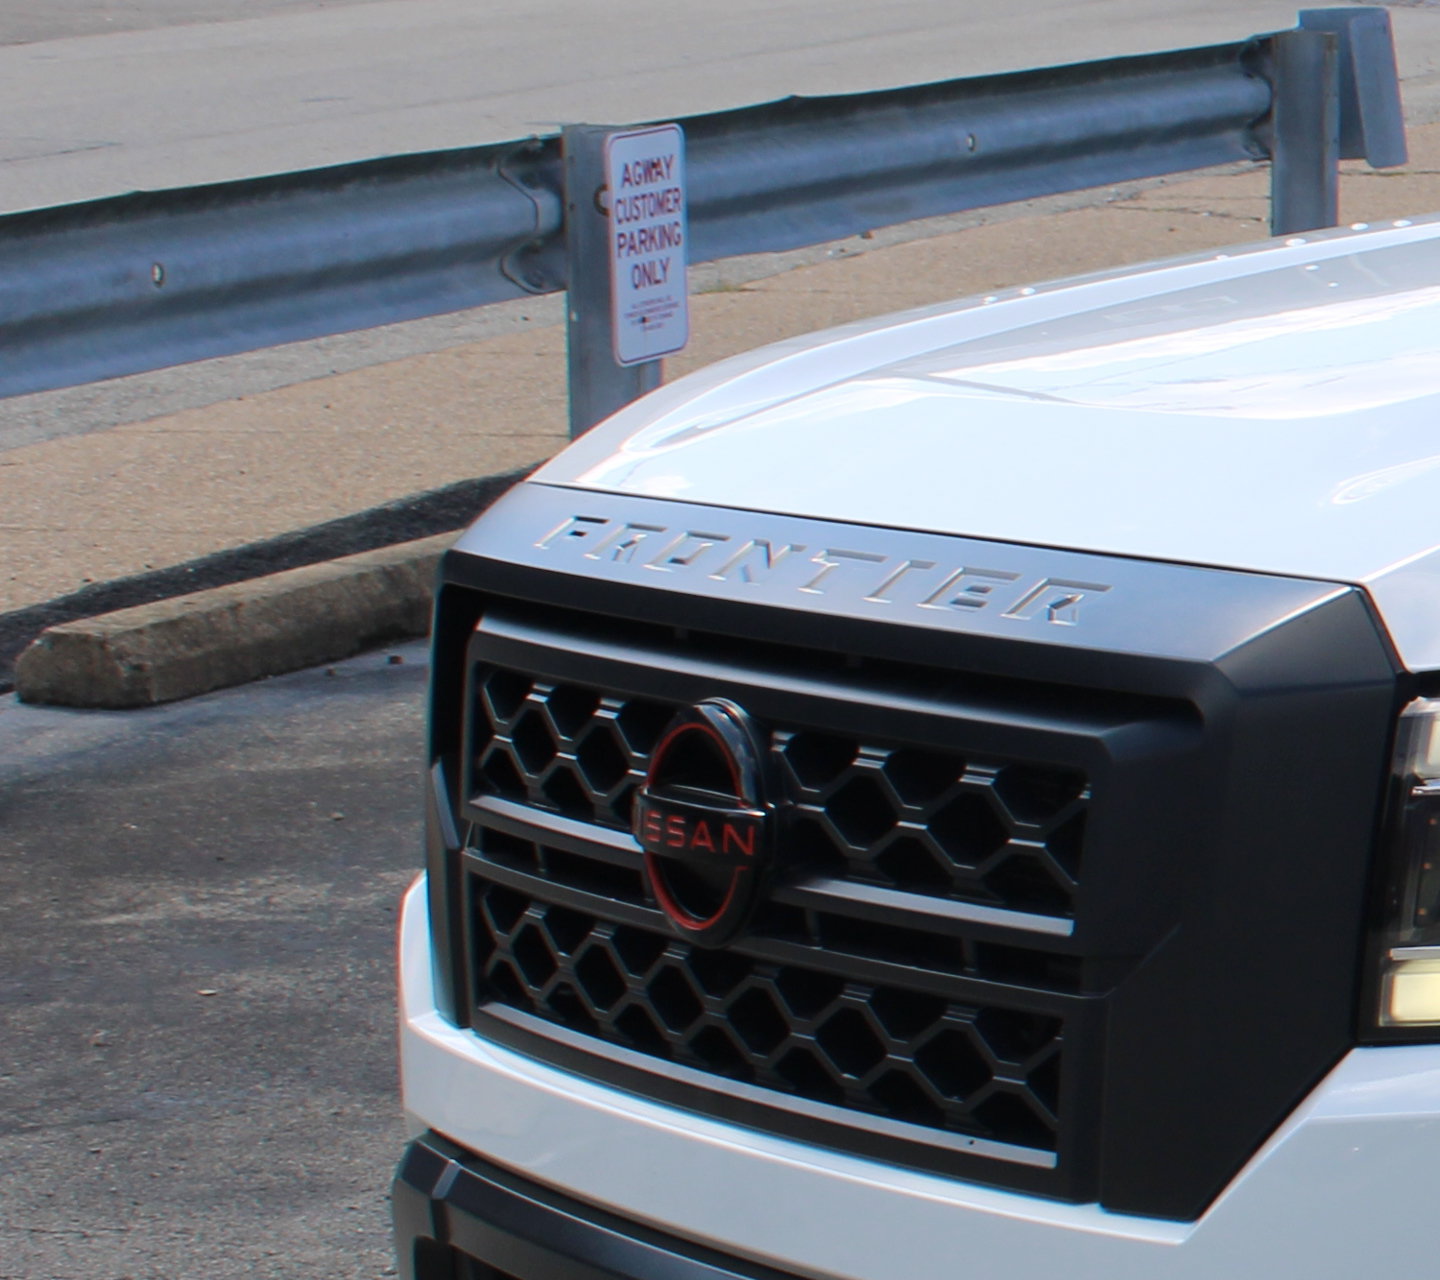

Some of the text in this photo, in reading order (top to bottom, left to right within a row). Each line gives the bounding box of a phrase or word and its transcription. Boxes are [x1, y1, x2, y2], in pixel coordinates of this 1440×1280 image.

[621, 154, 674, 188] AGWAY
[615, 187, 682, 225] CUSTOMER
[616, 221, 682, 258] PARKING
[631, 257, 671, 289] ONLY
[533, 514, 1113, 628] FRONTIER
